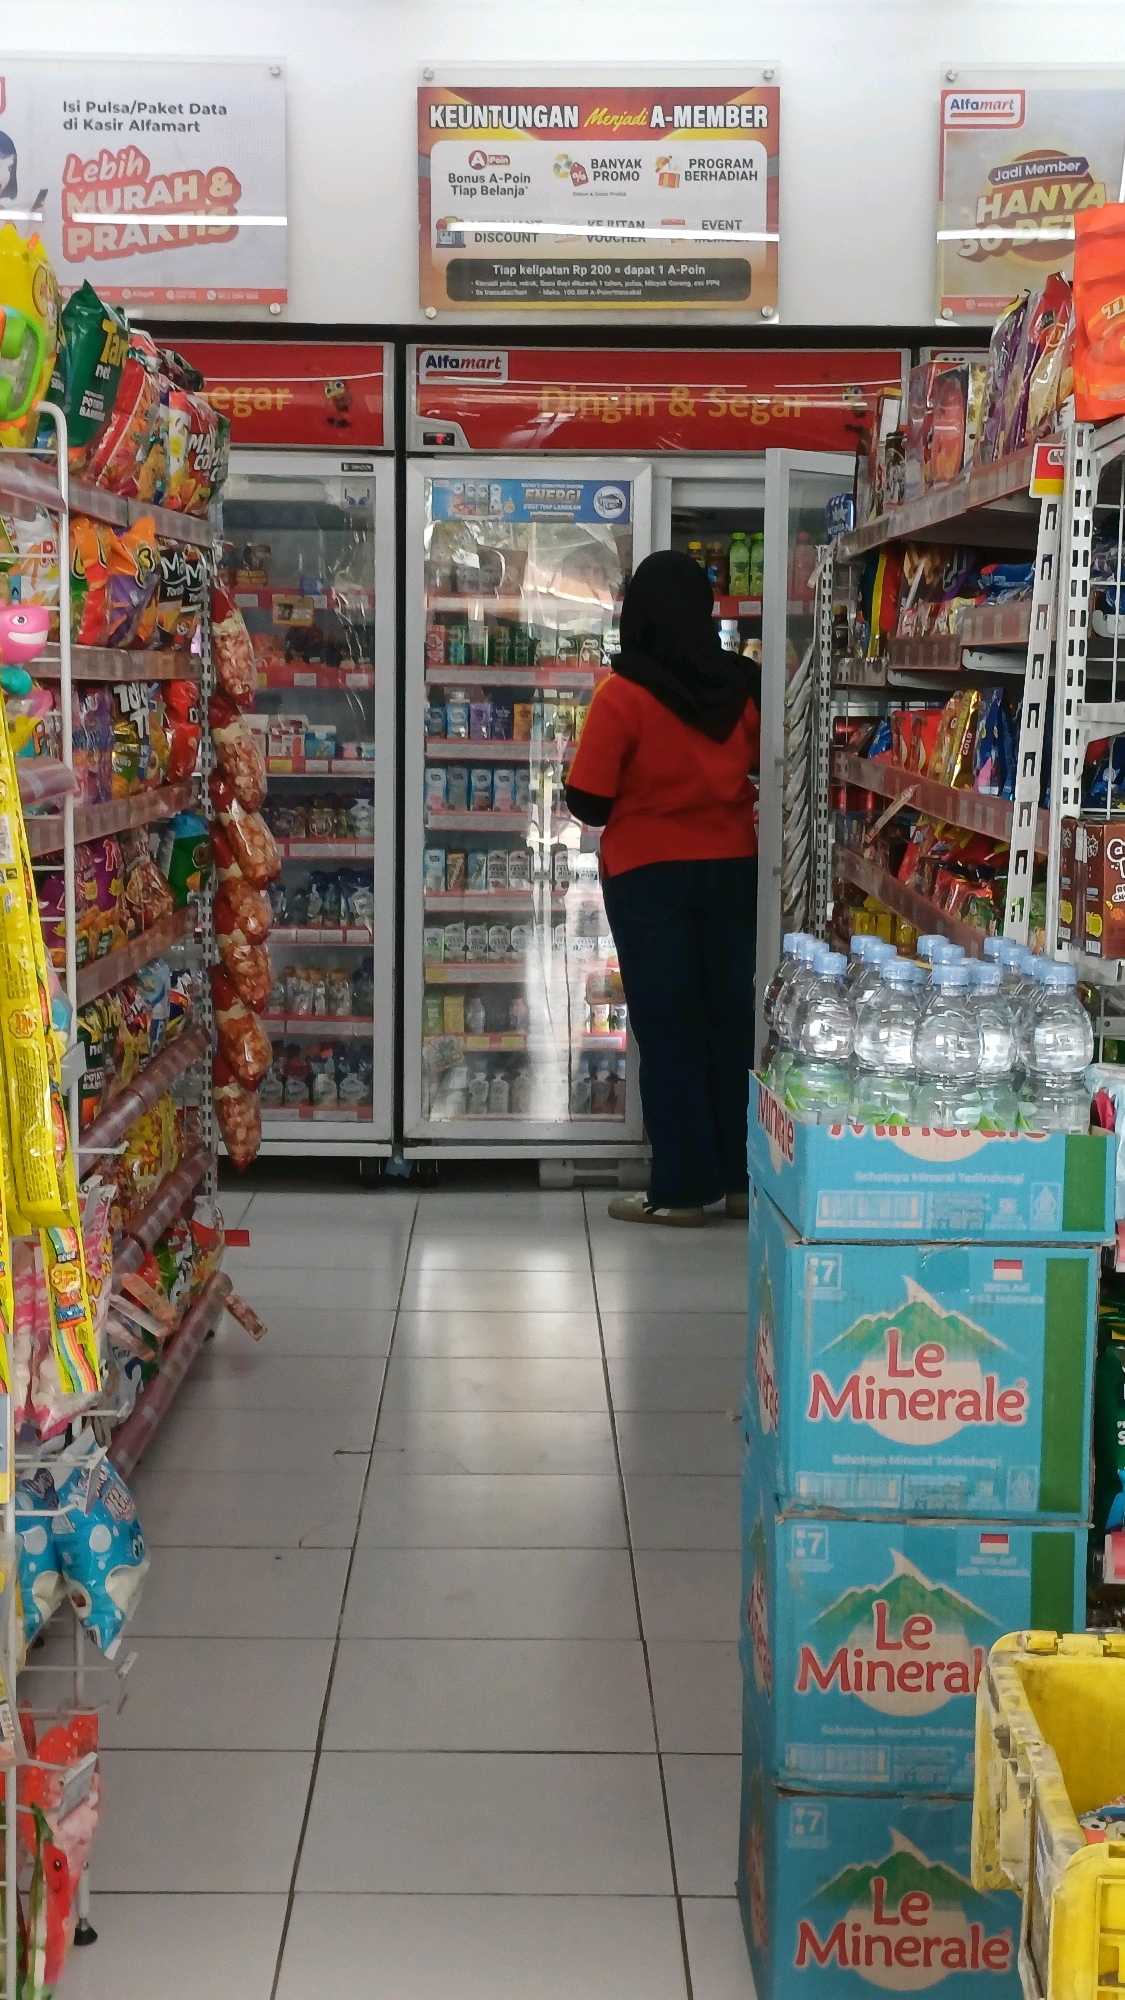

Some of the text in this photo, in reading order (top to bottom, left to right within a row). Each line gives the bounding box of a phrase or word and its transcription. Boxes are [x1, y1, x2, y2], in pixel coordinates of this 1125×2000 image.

[63, 101, 228, 116] Isi Pulsa/Paket Data
[950, 98, 1015, 112] Alfamart
[63, 119, 201, 133] di Kasir Alfamart
[429, 104, 769, 133] KEUNTUNGAN Menjadi A-MEMBER
[65, 149, 144, 184] Lebih
[590, 158, 642, 169] BANYAK
[688, 158, 754, 169] PROGRAM
[994, 160, 1081, 183] Jadi Member
[448, 173, 531, 185] Bonus A-Poin
[592, 170, 640, 182] PROMO
[684, 170, 758, 182] BERHADIAH
[66, 171, 233, 217] MURAH &
[451, 185, 477, 198] Tiap
[975, 182, 1108, 226] HANYA
[701, 219, 743, 230] EVENT
[474, 232, 539, 243] DISCOUNT
[492, 264, 517, 277] Tiap
[519, 263, 570, 277] kelipatan
[572, 264, 588, 277] Rp
[590, 264, 612, 275] 200
[623, 264, 656, 277] dapat
[658, 264, 664, 275] 1
[667, 263, 706, 275] A-Poin
[425, 353, 503, 371] Alfamart
[201, 386, 291, 418] egar
[540, 385, 808, 425] Dingin & Segar
[525, 489, 581, 502] ENERGI
[887, 1329, 945, 1379] Le
[808, 1373, 1025, 1422] Minerale
[875, 1602, 933, 1651] Le
[797, 1647, 981, 1694] Mineral
[873, 1877, 930, 1926] Le
[796, 1924, 1011, 1970] Minerale
